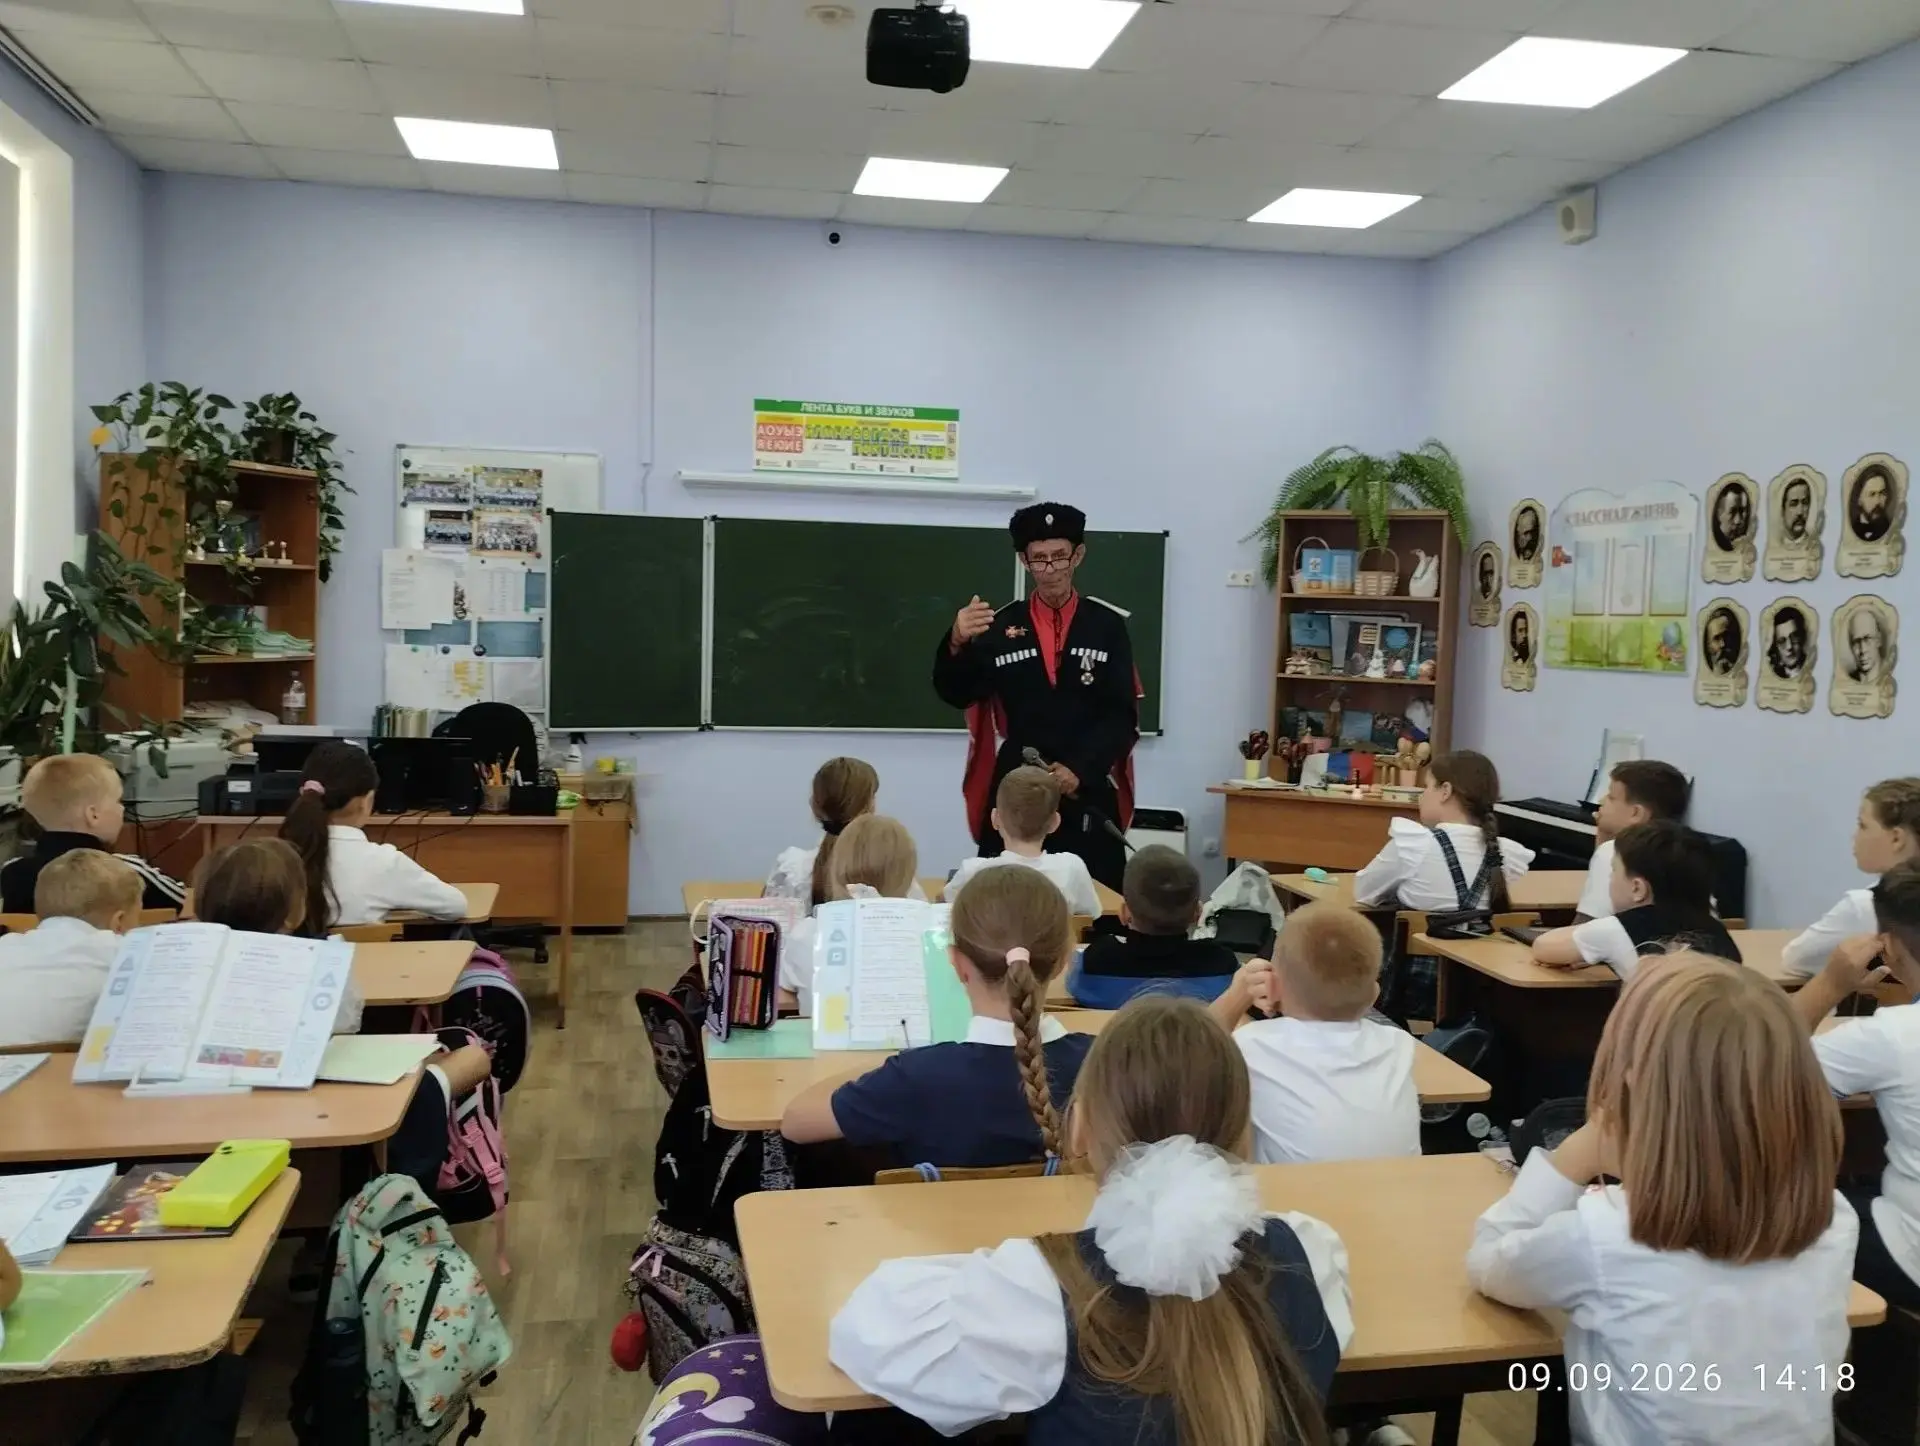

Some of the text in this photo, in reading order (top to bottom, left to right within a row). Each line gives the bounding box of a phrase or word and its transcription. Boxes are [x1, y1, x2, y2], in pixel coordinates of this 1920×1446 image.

[800, 402, 915, 418] ЛЕНТА БУКВ И ЗВУКОВ
